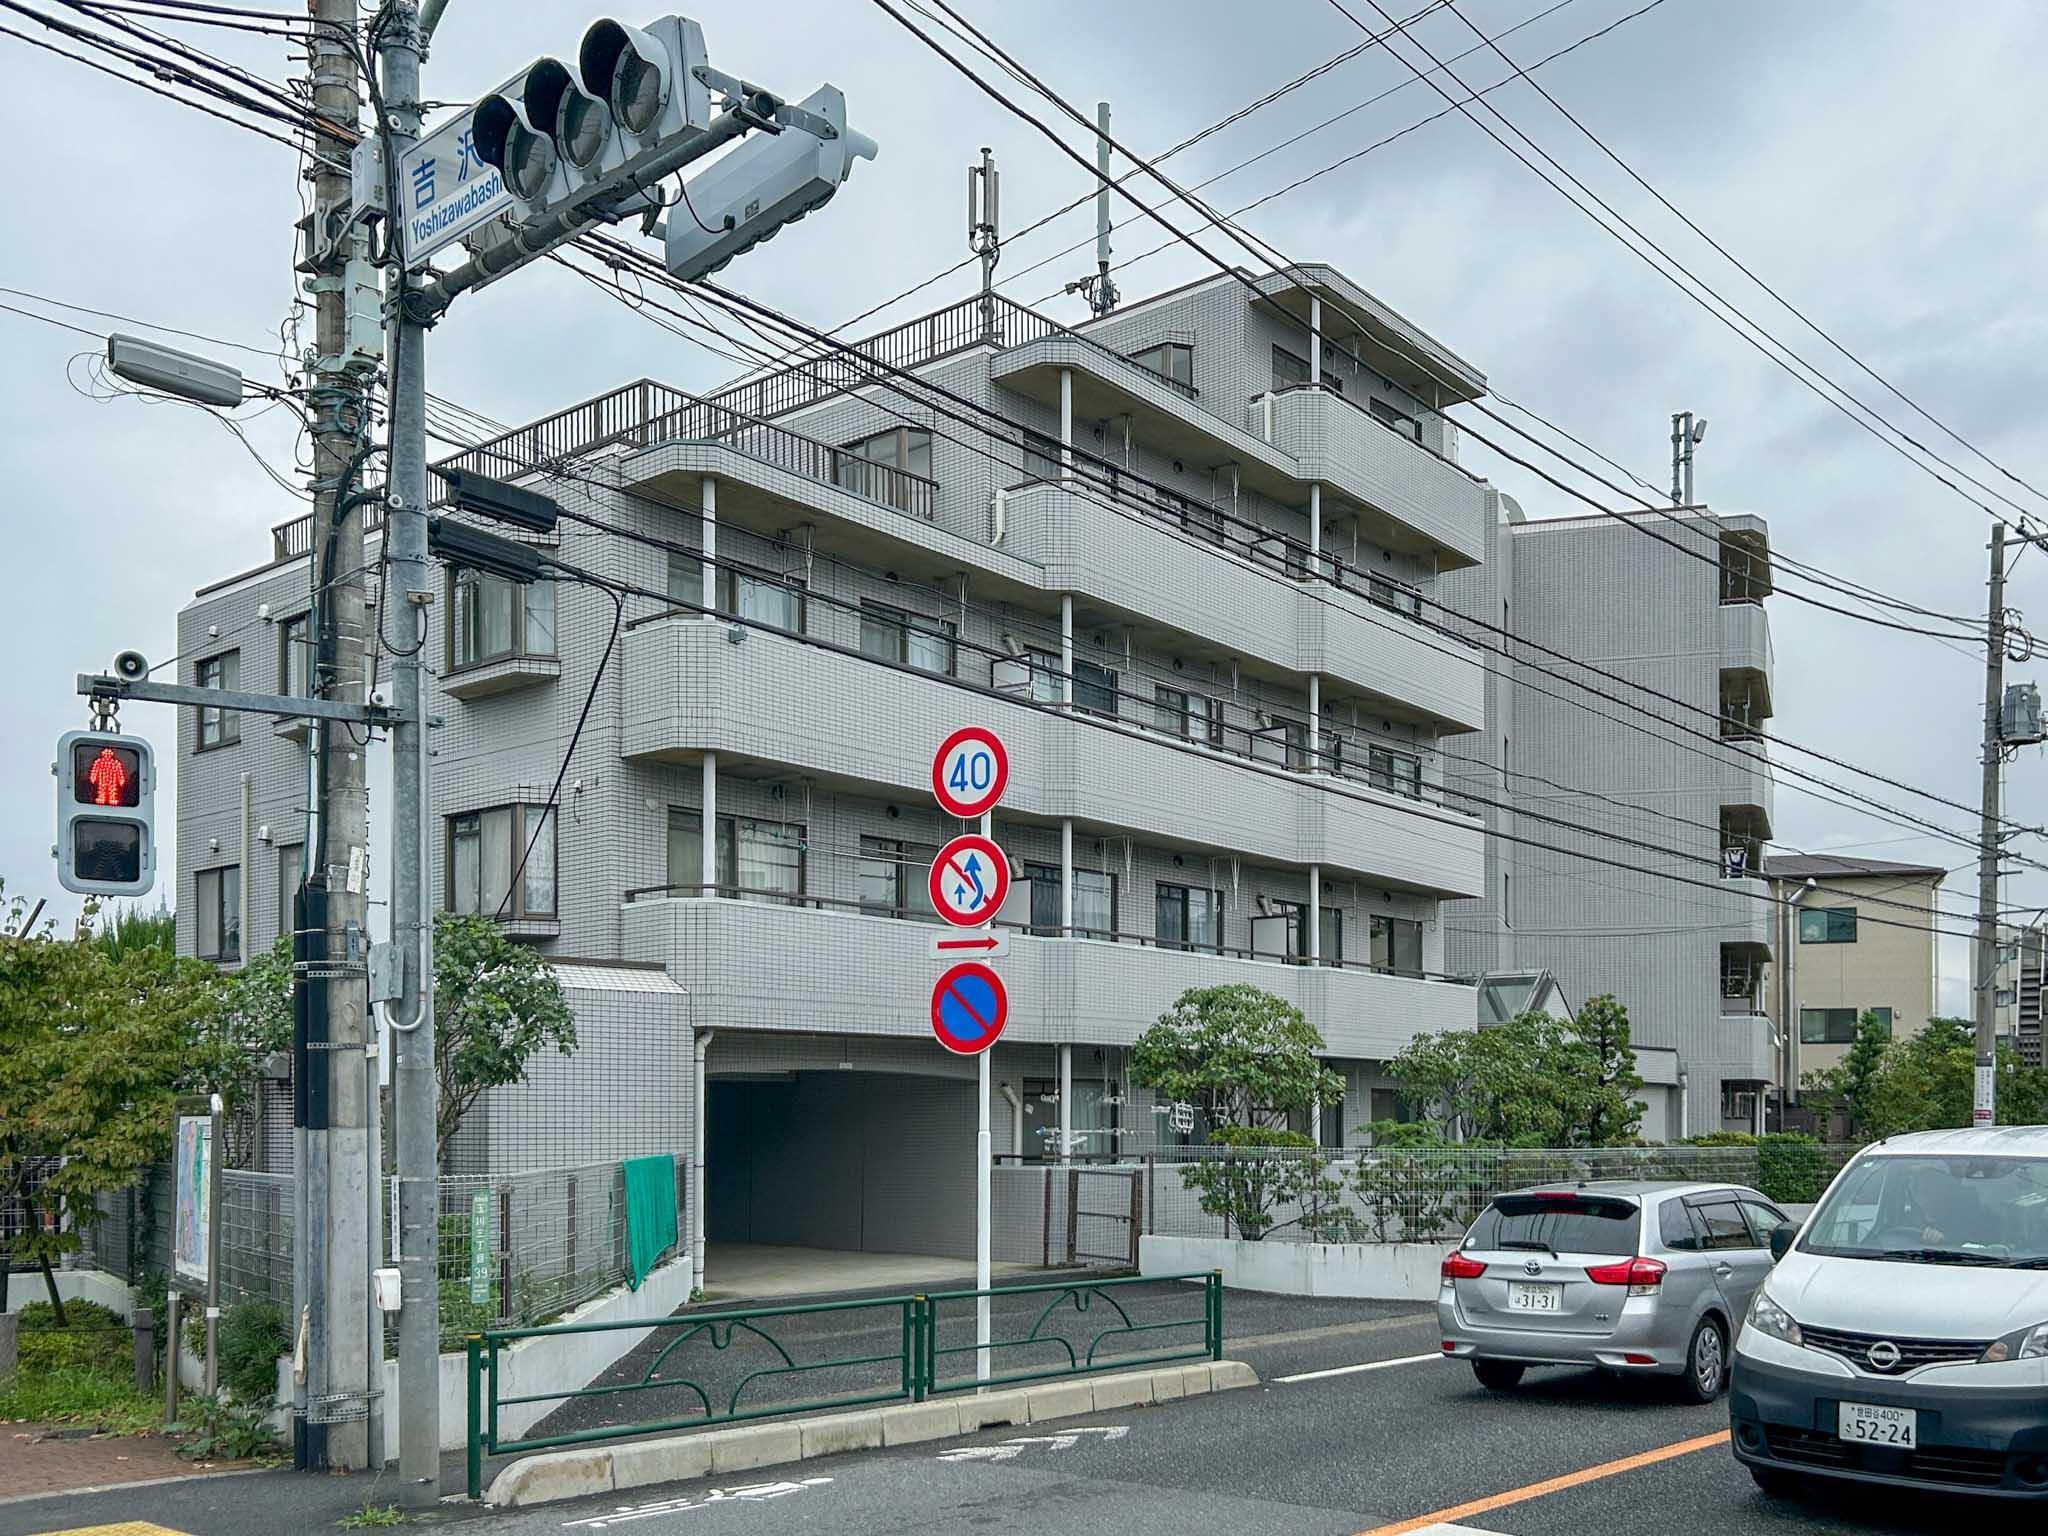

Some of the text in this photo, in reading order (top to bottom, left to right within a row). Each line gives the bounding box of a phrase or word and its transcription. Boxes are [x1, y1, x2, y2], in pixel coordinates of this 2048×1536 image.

[411, 171, 503, 244] Yoshizawabashi
[949, 751, 991, 792] 40
[474, 1267, 488, 1280] 39
[1521, 1294, 1555, 1309] 31-31
[1856, 1419, 1912, 1445] 52-24
